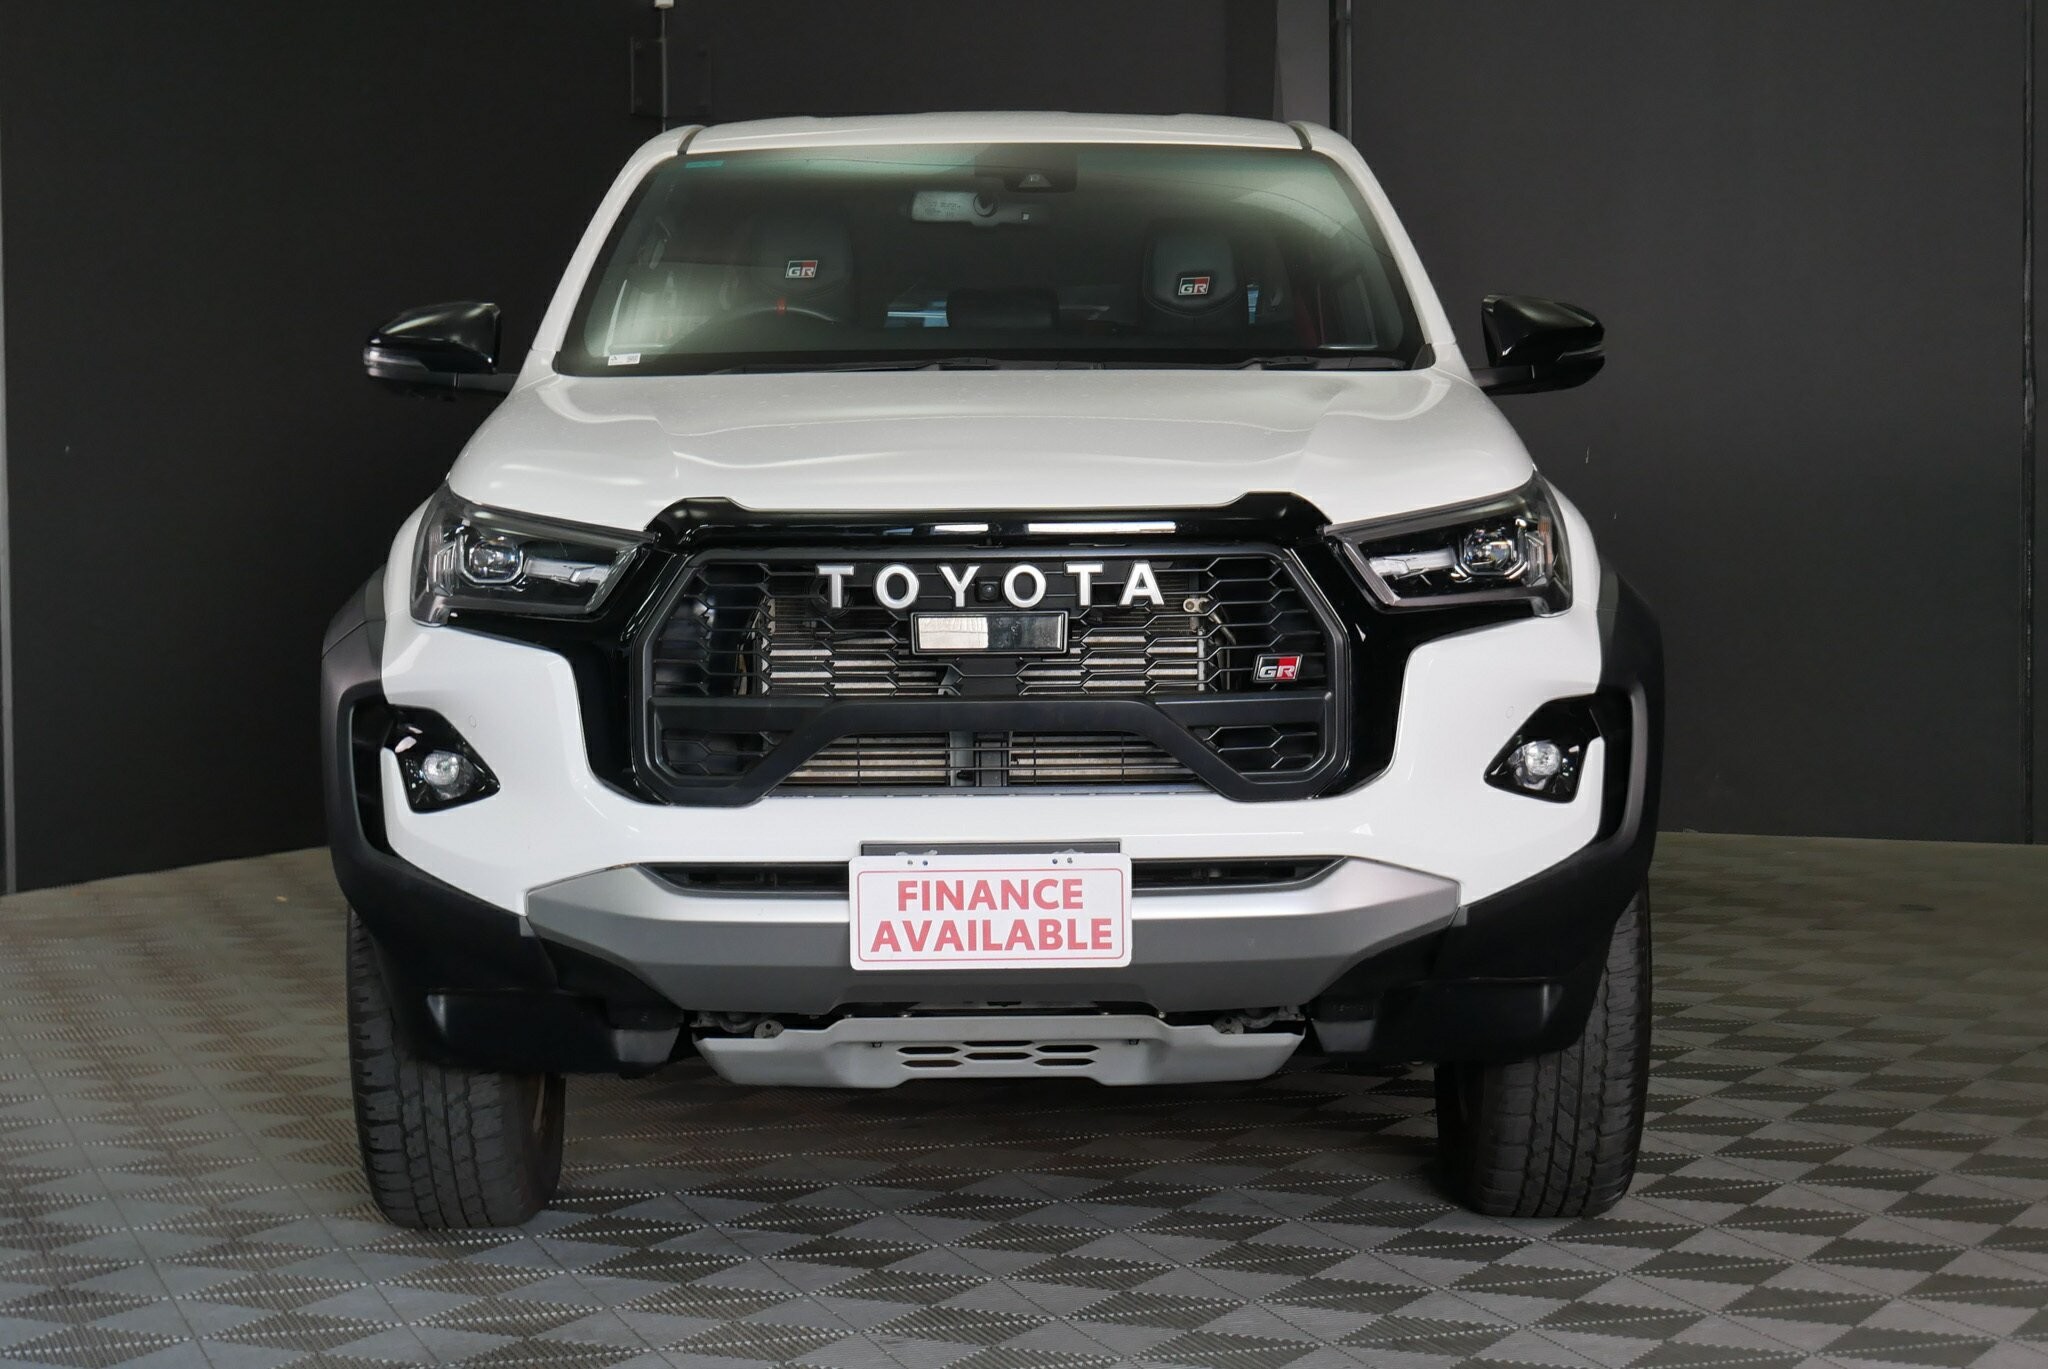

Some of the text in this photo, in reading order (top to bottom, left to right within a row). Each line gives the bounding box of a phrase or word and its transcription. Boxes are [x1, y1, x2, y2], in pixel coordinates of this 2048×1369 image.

[815, 562, 1165, 609] TOYOTA
[897, 878, 1084, 912] FINANCE
[870, 918, 1113, 953] AVAILABLE
